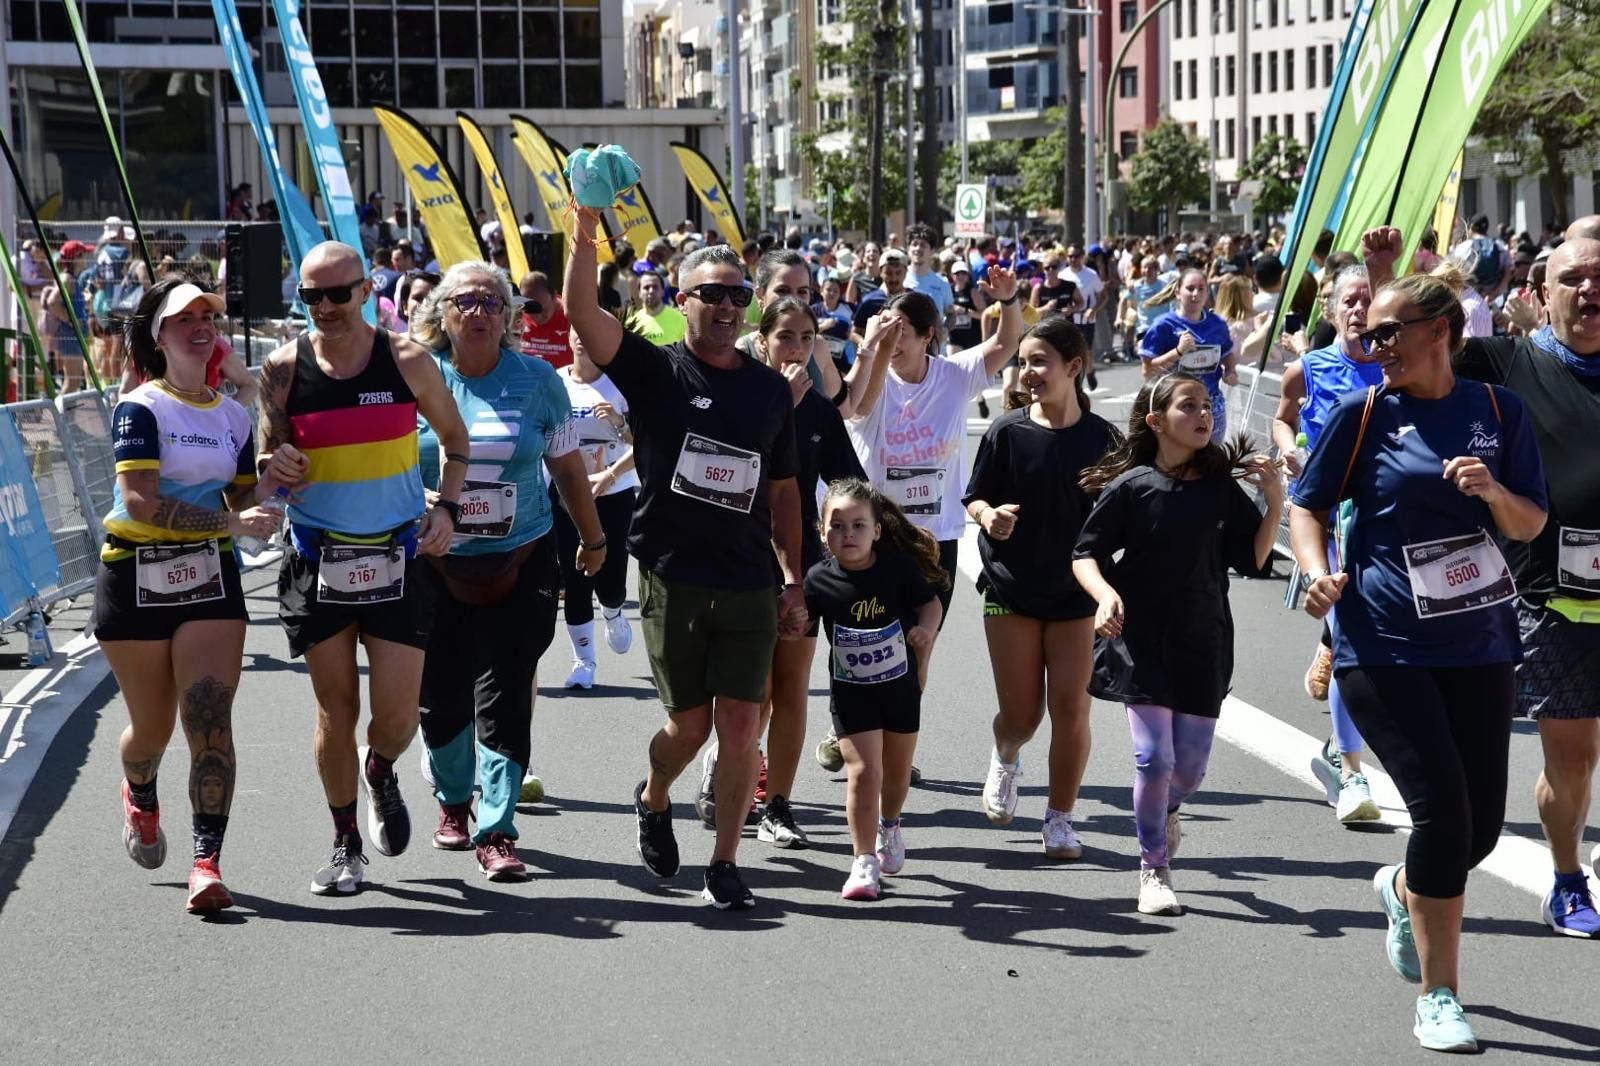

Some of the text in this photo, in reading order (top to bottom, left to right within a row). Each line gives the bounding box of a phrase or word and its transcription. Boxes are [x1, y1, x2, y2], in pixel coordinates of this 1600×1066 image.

[358, 392, 394, 405] 226ERS
[181, 433, 218, 446] cofarca
[885, 423, 935, 446] toda
[880, 437, 945, 466] leche!
[705, 466, 735, 482] 5627
[906, 485, 929, 499] 3710
[462, 501, 490, 516] 8026
[167, 566, 197, 585] 5276
[348, 568, 377, 585] 2167
[1445, 562, 1480, 587] 5500
[850, 596, 885, 622] Mia
[846, 645, 895, 667] 9032
